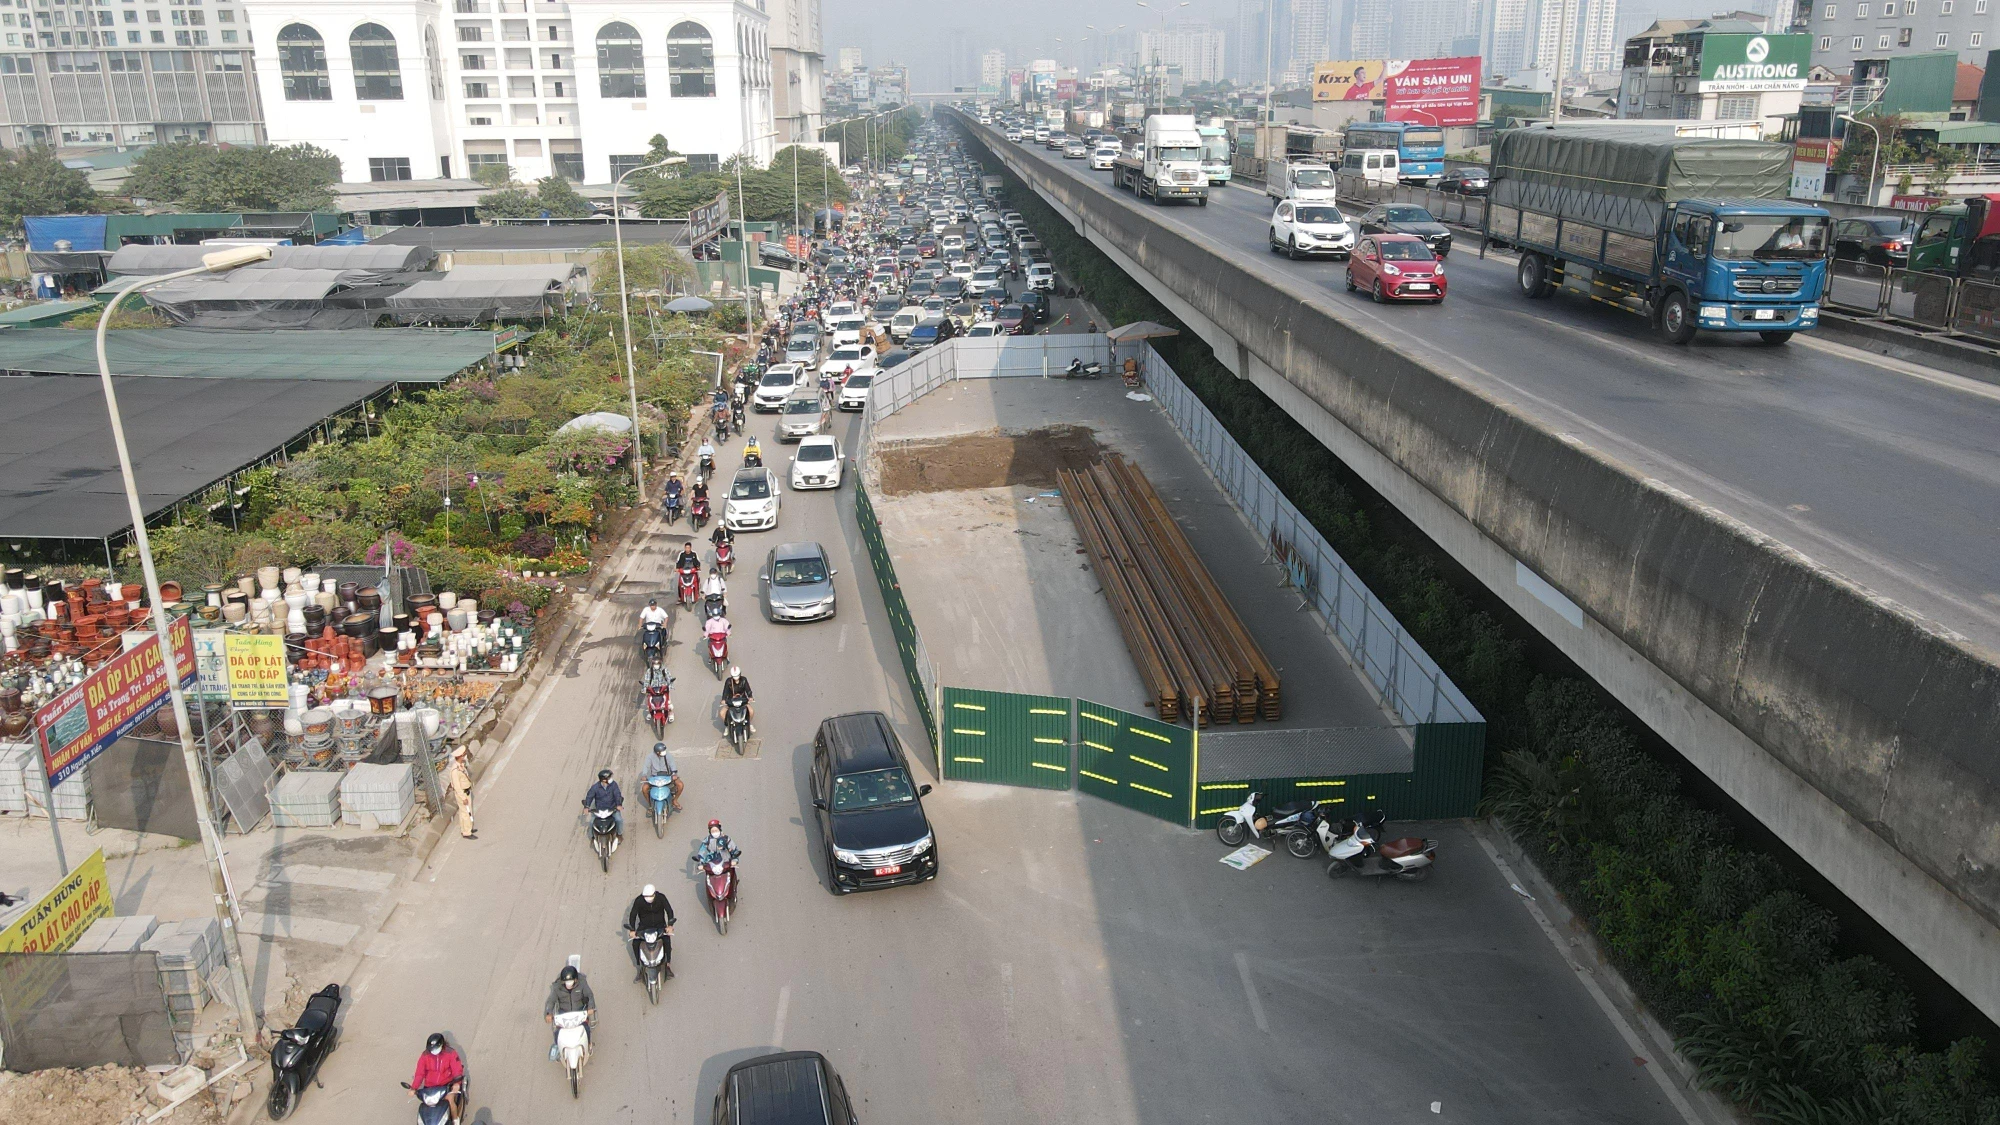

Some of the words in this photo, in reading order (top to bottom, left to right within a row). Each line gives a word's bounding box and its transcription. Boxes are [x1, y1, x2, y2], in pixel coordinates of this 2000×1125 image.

[1318, 74, 1351, 84] Kixx
[1394, 75, 1418, 86] VÁN
[1422, 74, 1447, 86] SÀN
[1450, 74, 1472, 84] UNI
[1714, 64, 1798, 78] AUSTRONG
[230, 654, 244, 666] ĐÁ
[247, 653, 261, 666] ỐP
[264, 654, 282, 666] LÁT
[236, 669, 256, 679] CAO
[259, 666, 279, 679] CẤP
[88, 676, 106, 708] ĐÁ
[107, 664, 122, 695] ỐP
[124, 654, 144, 685] LÁT
[96, 704, 108, 721] Đá
[109, 691, 130, 714] Trang
[130, 678, 141, 696] Trí
[145, 672, 155, 686] Đá
[41, 704, 62, 726] Tuấn
[52, 748, 70, 771] NHẬN
[70, 740, 79, 757] TƯ
[79, 730, 93, 750] VẤN
[97, 716, 113, 733] THIẾT
[113, 708, 122, 730] KẾ
[126, 702, 135, 716] THI
[135, 690, 151, 711] CÔNG
[151, 680, 163, 695] CÁC
[57, 766, 70, 781] 310
[70, 752, 90, 772] Nguyễn
[116, 719, 134, 737] Hotline:
[20, 901, 52, 936] TUẤN
[54, 874, 83, 908] HÙNG
[39, 918, 60, 952] LÁT
[61, 899, 81, 932] CAO
[83, 877, 101, 911] CẤP
